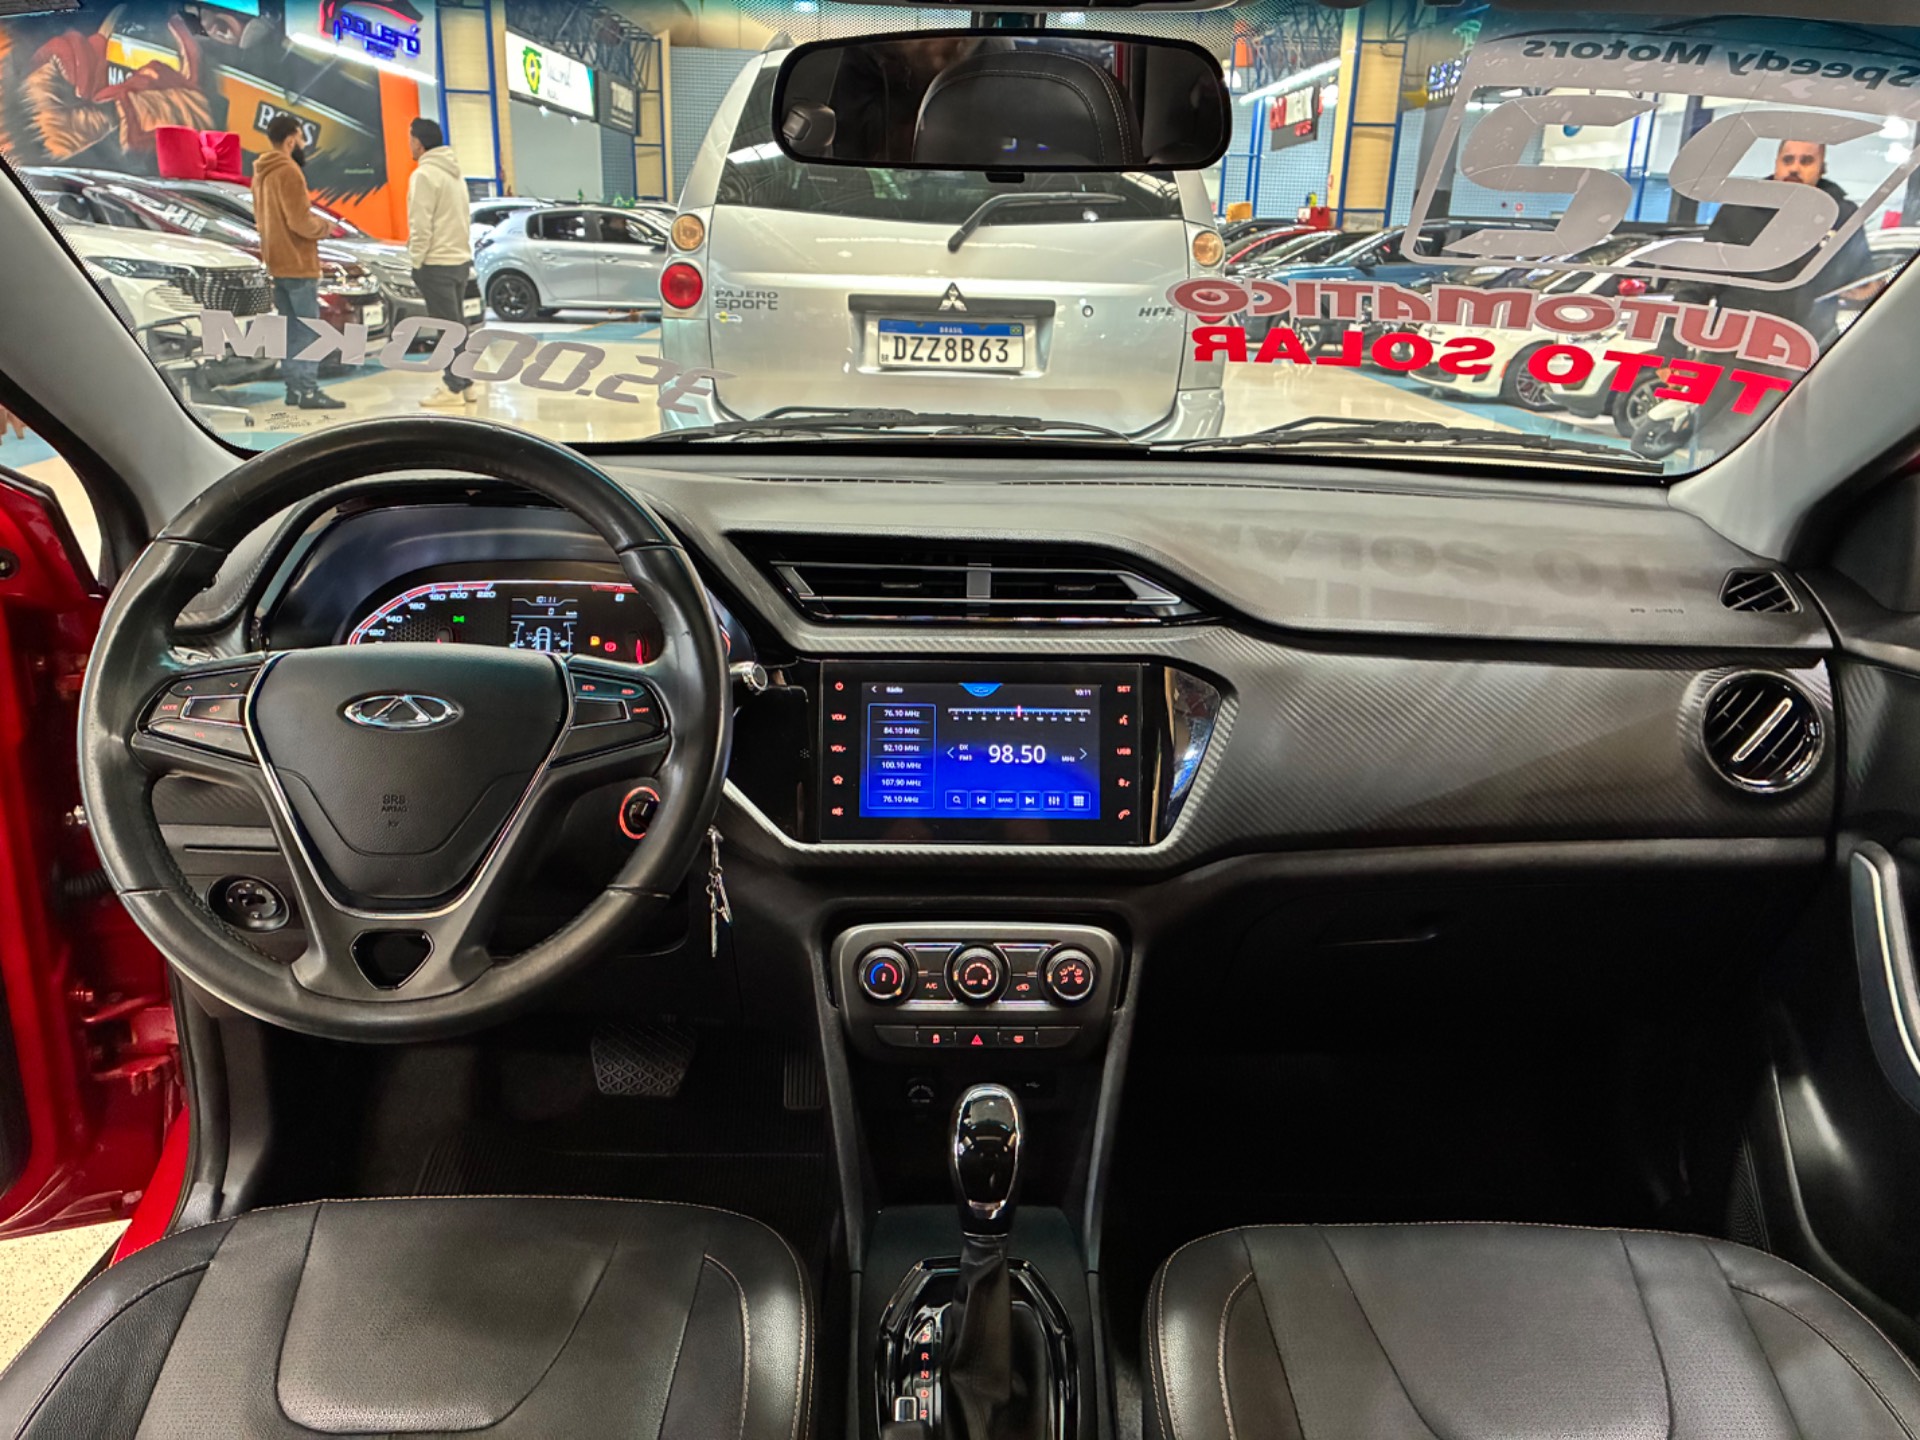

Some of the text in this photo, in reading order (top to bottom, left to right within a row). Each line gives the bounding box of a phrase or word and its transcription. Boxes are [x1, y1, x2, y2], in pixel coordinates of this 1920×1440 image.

[715, 290, 779, 299] PAJERO
[939, 326, 963, 334] BRASIL
[893, 335, 1009, 363] DZZ8B63
[450, 591, 468, 599] 200
[385, 615, 402, 623] 140
[884, 709, 920, 718] 76.10 MHz
[904, 726, 920, 735] MHz
[883, 744, 920, 753] 92.10 MHz
[988, 744, 1046, 764] 98.50
[906, 761, 922, 770] MHz
[906, 778, 922, 787] MHz
[903, 795, 919, 804] MHz
[925, 982, 938, 990] A/C
[921, 1352, 929, 1361] R
[921, 1370, 929, 1379] N
